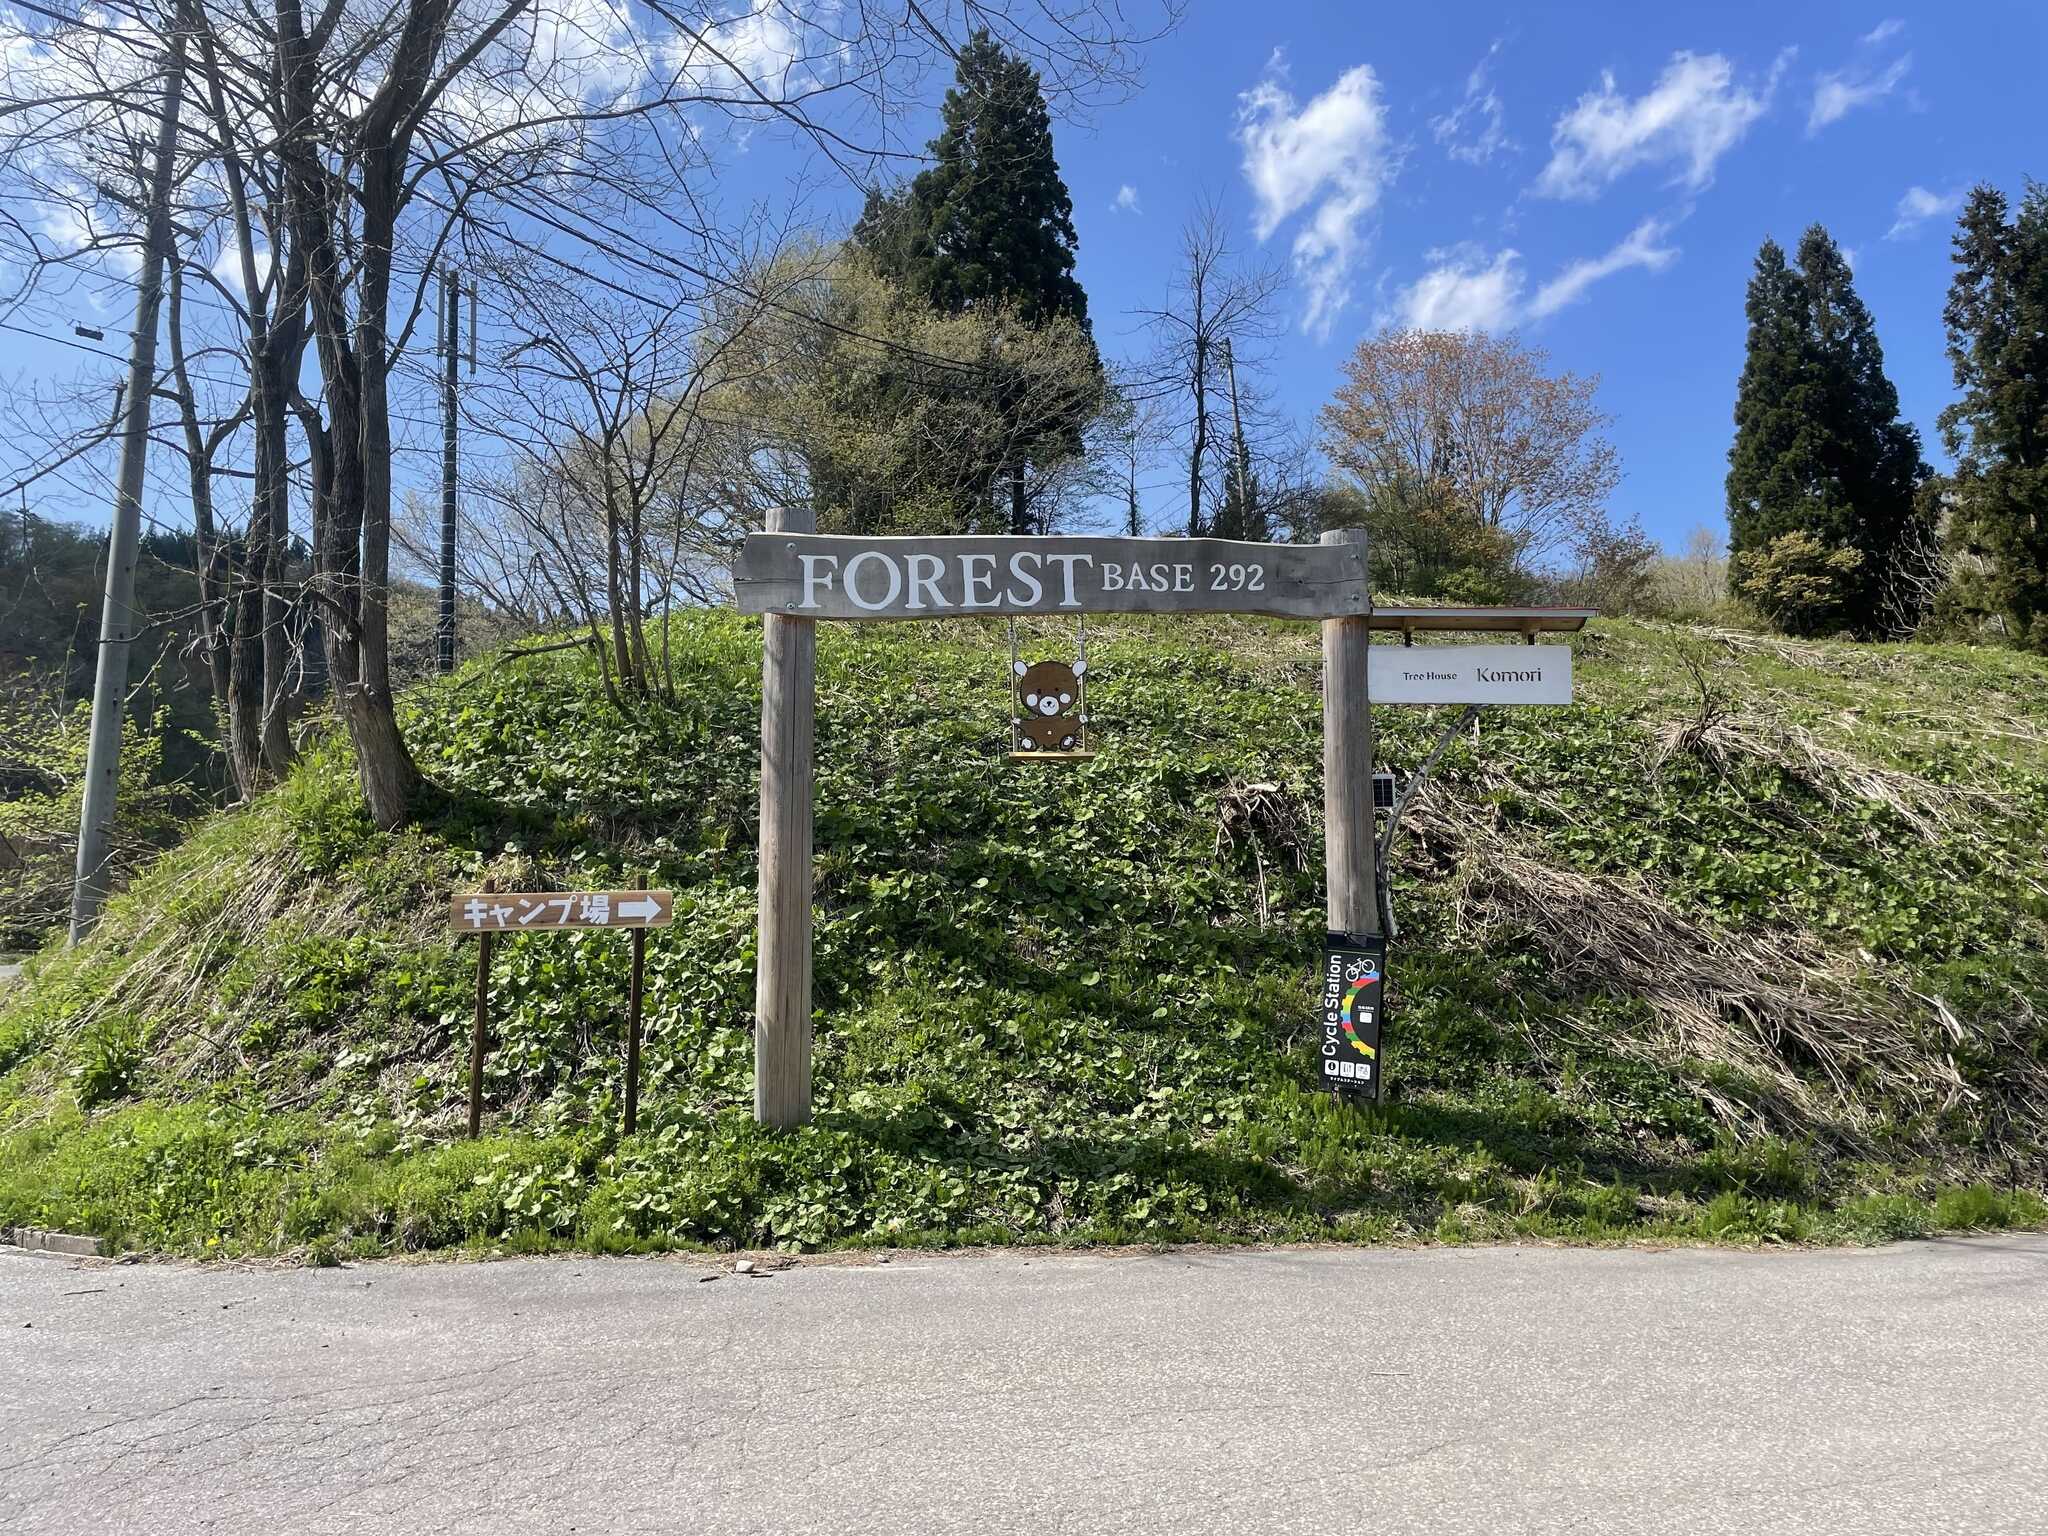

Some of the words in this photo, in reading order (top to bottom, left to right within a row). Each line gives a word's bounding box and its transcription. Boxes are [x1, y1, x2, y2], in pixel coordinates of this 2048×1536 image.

[797, 551, 1094, 610] FOREST
[1101, 562, 1196, 593] BASE
[1209, 562, 1266, 592] 292
[1403, 672, 1424, 680] Tree
[1426, 672, 1457, 680] House
[1477, 667, 1541, 681] Komori
[464, 895, 610, 927] キャンプ場
[1324, 954, 1341, 1009] Station
[1321, 1012, 1340, 1056] Cycle
